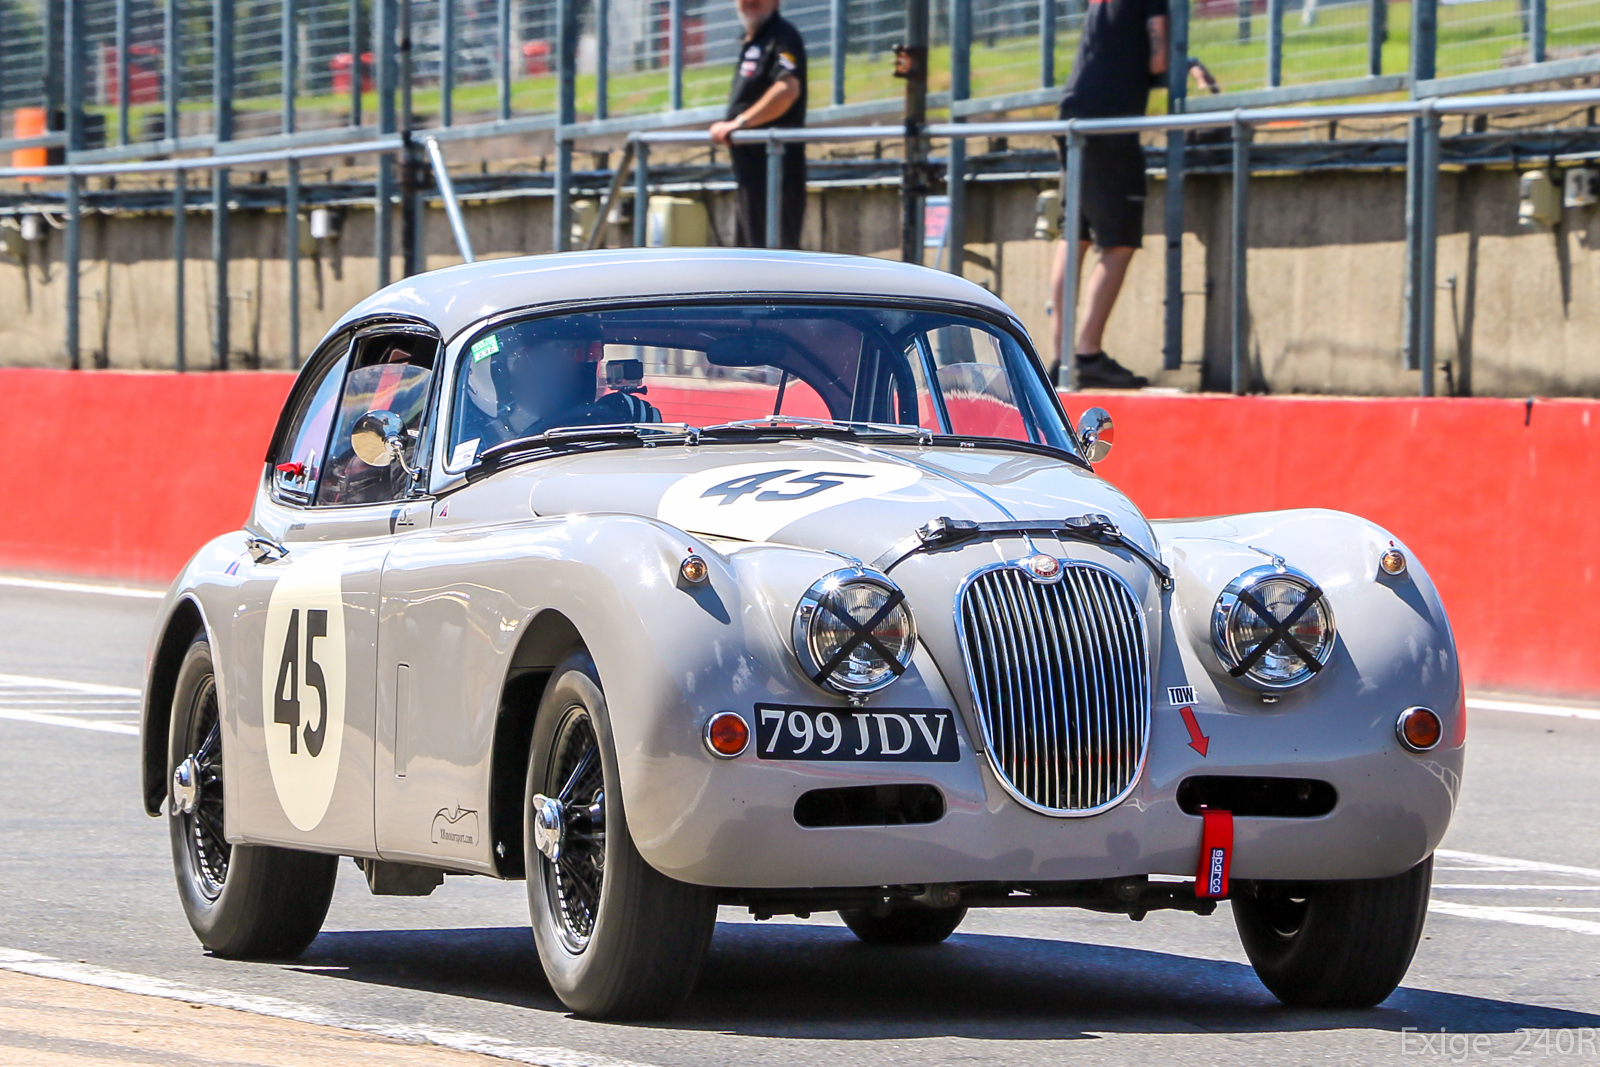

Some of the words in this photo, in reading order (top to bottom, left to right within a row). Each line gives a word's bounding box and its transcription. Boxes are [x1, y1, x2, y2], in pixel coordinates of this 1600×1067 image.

[699, 469, 875, 506] 45
[273, 608, 328, 758] 45
[1168, 687, 1194, 704] TOW
[760, 709, 843, 755] 799
[851, 713, 948, 756] JDV
[1211, 849, 1224, 894] sparco
